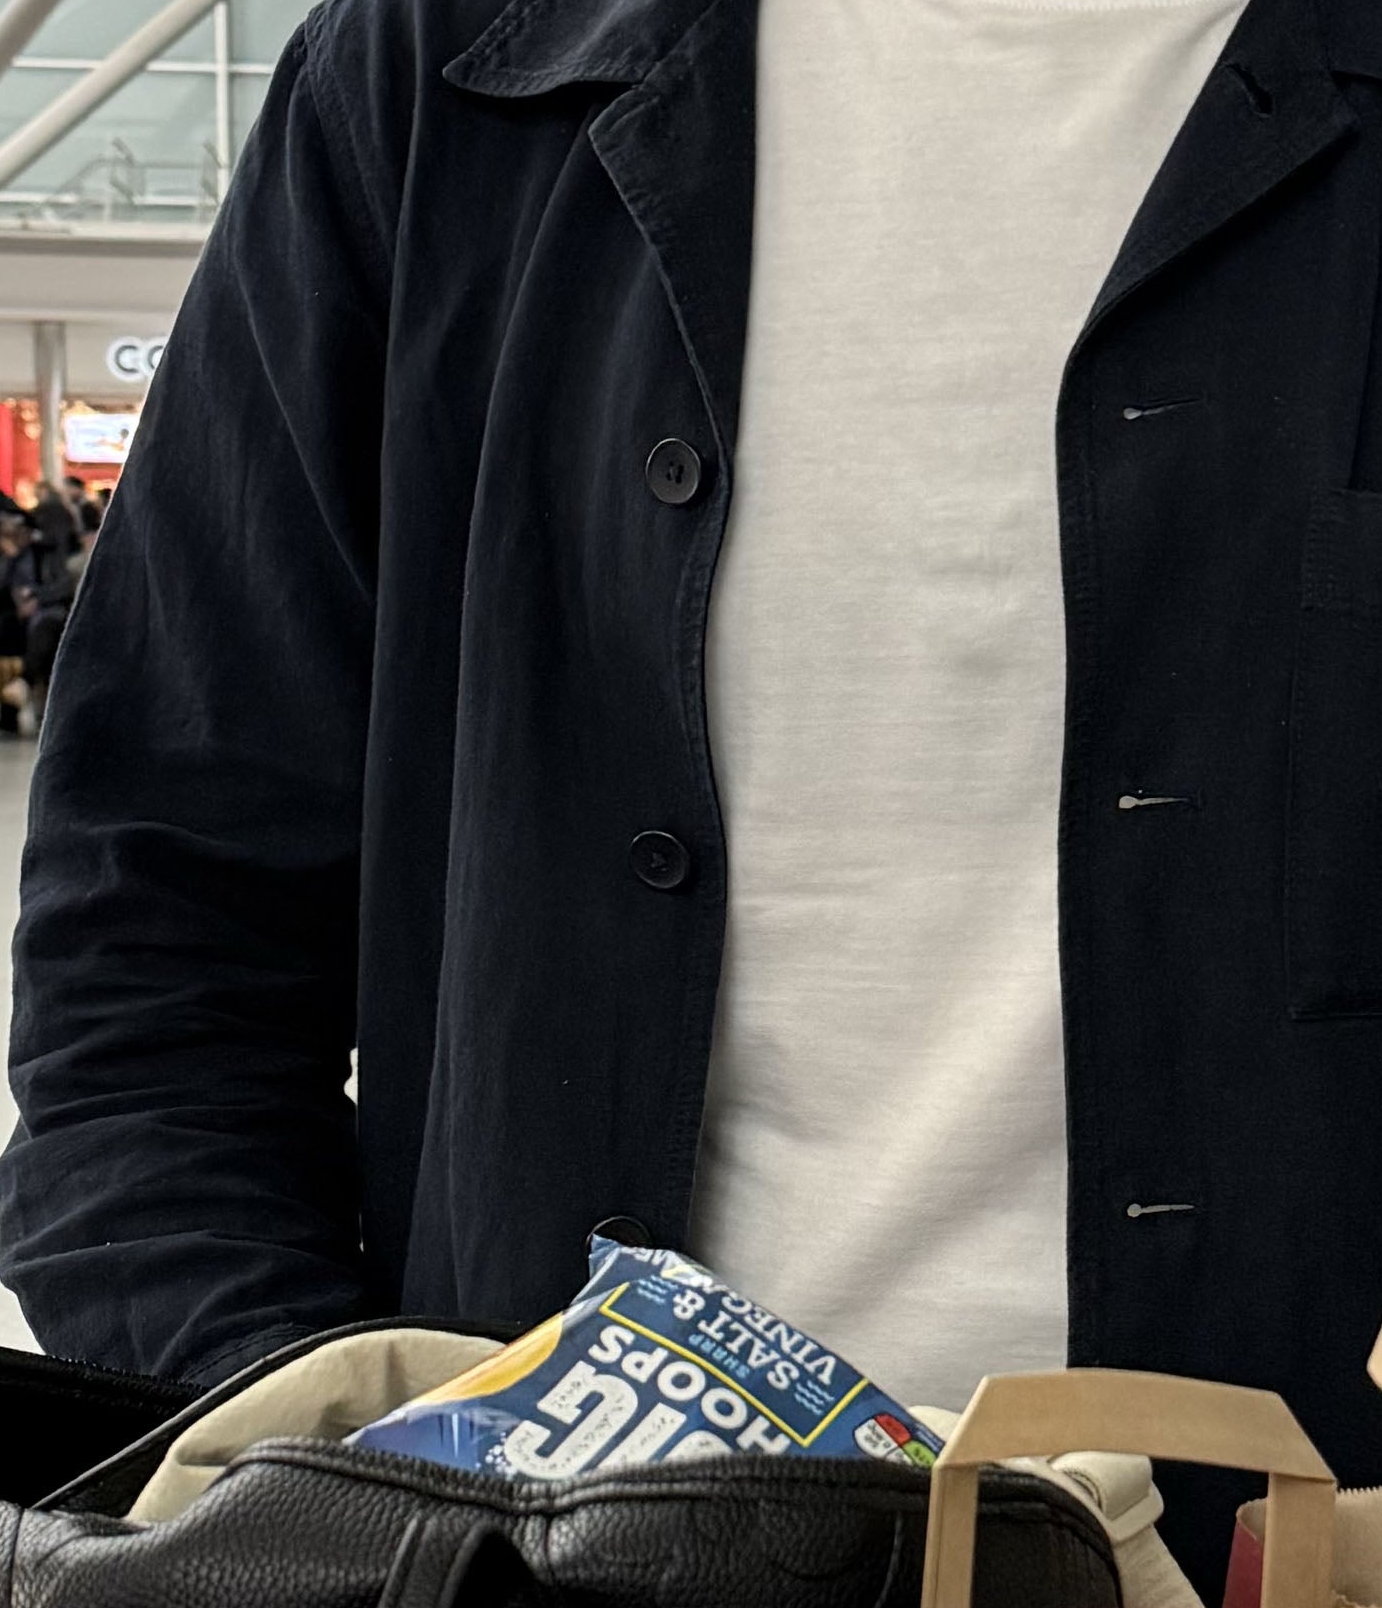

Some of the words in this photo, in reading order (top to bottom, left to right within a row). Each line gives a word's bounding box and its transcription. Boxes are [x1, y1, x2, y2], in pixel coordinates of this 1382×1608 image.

[672, 1287, 712, 1321] &
[689, 1333, 751, 1380] SHARP
[699, 1314, 798, 1390] SALT
[589, 1323, 791, 1457] HOOPS
